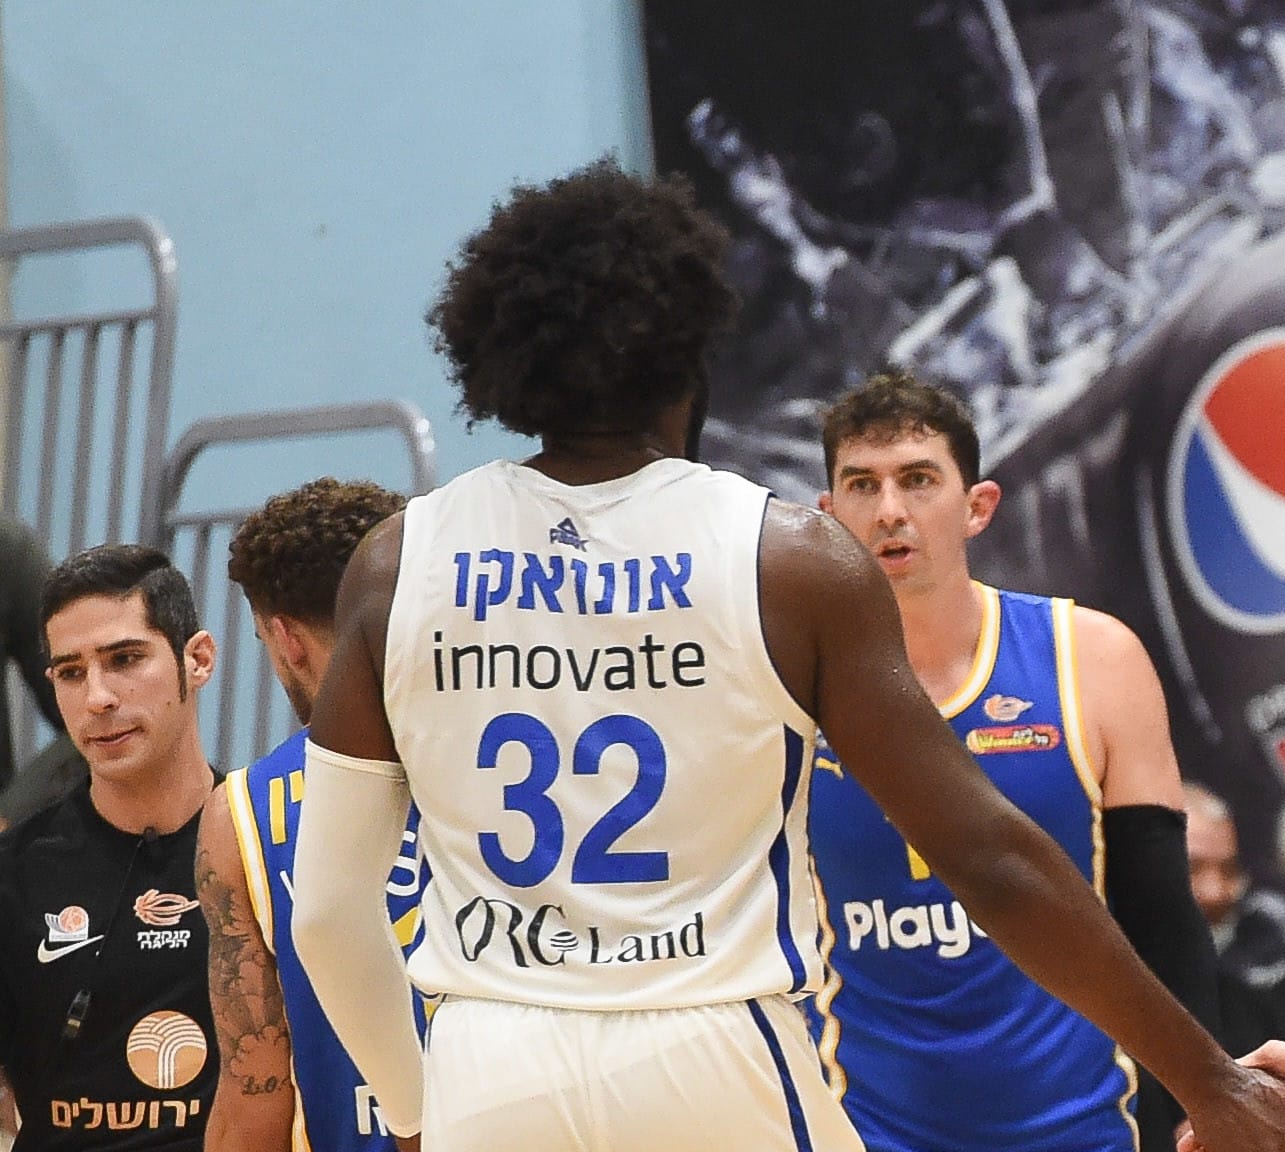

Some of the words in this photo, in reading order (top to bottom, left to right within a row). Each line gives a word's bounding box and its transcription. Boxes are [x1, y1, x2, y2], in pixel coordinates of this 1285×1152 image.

[454, 548, 692, 622] אונואקו
[434, 631, 705, 692] innovate
[477, 713, 669, 888] 32
[455, 896, 578, 968] ORG
[588, 911, 707, 964] Land
[843, 898, 988, 959] Play
[51, 1097, 200, 1130] ירושלים
